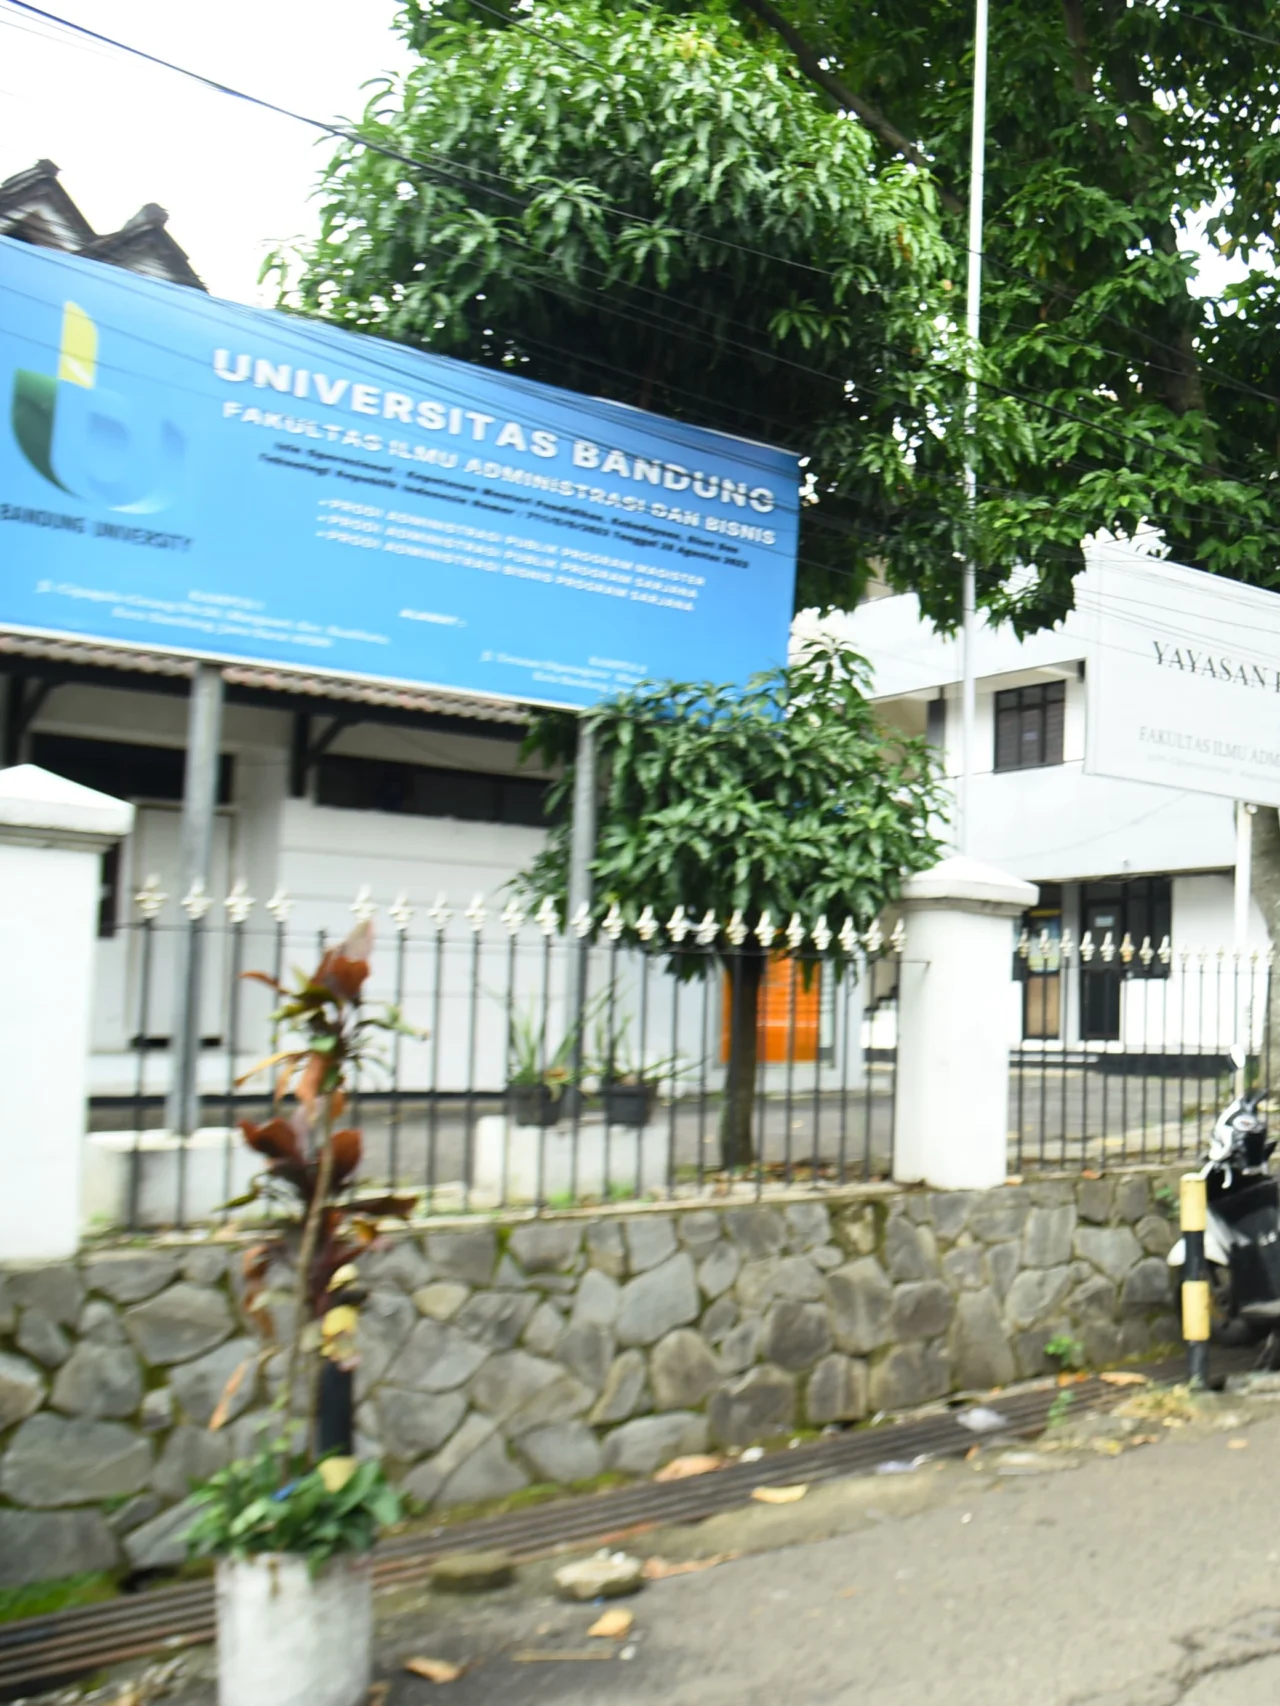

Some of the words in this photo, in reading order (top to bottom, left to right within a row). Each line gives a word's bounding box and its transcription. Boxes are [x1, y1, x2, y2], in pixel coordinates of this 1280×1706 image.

[213, 349, 558, 458] UNIVERSITAS
[572, 440, 776, 513] BANDUNG
[222, 401, 383, 452] FAKULTAS
[388, 439, 458, 468] ILMU
[463, 457, 646, 512] ADMINISTRASI
[650, 503, 700, 527] DAN
[705, 516, 776, 545] BISNIS
[1152, 640, 1269, 689] YAYASAN
[1138, 726, 1211, 754] FAKULTAS
